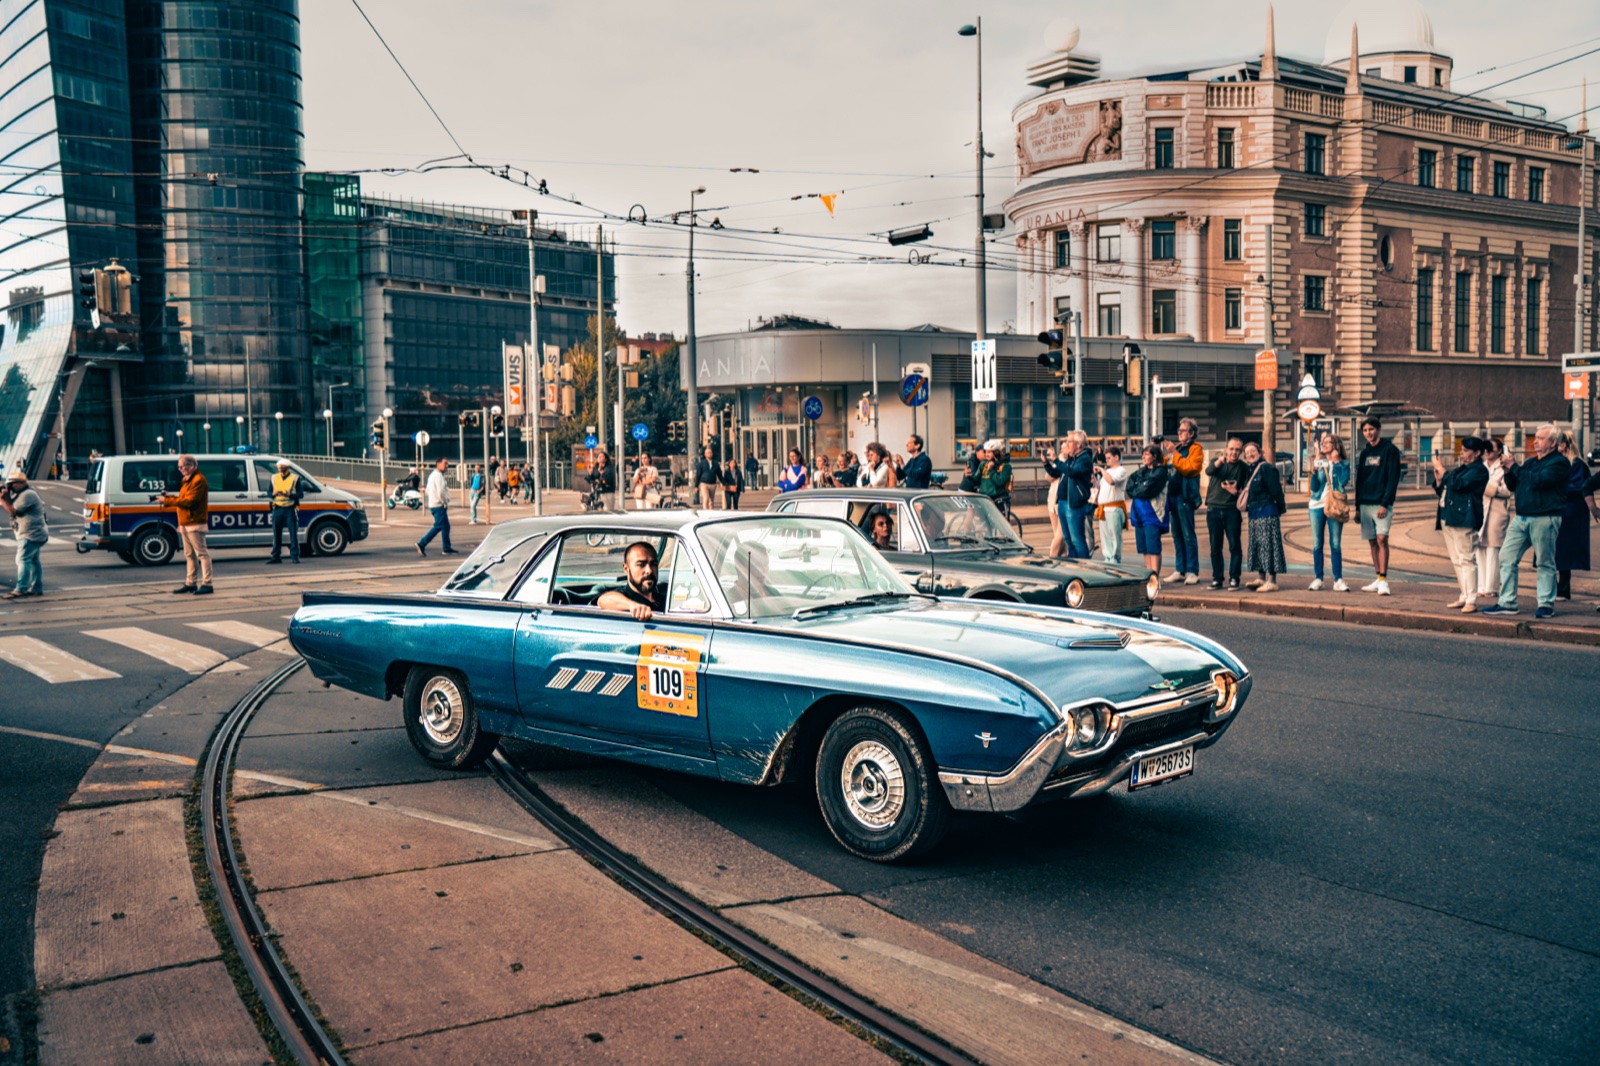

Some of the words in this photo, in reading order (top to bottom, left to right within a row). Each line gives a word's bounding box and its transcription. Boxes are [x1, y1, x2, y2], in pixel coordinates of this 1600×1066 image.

[1049, 130, 1076, 143] JOSEPH
[1027, 207, 1087, 231] URANIA
[509, 354, 521, 386] VHS
[681, 354, 771, 380] ANIA
[147, 480, 166, 490] 133
[211, 513, 273, 527] POLIZE
[653, 667, 682, 697] 109
[845, 832, 886, 849] NEXEN
